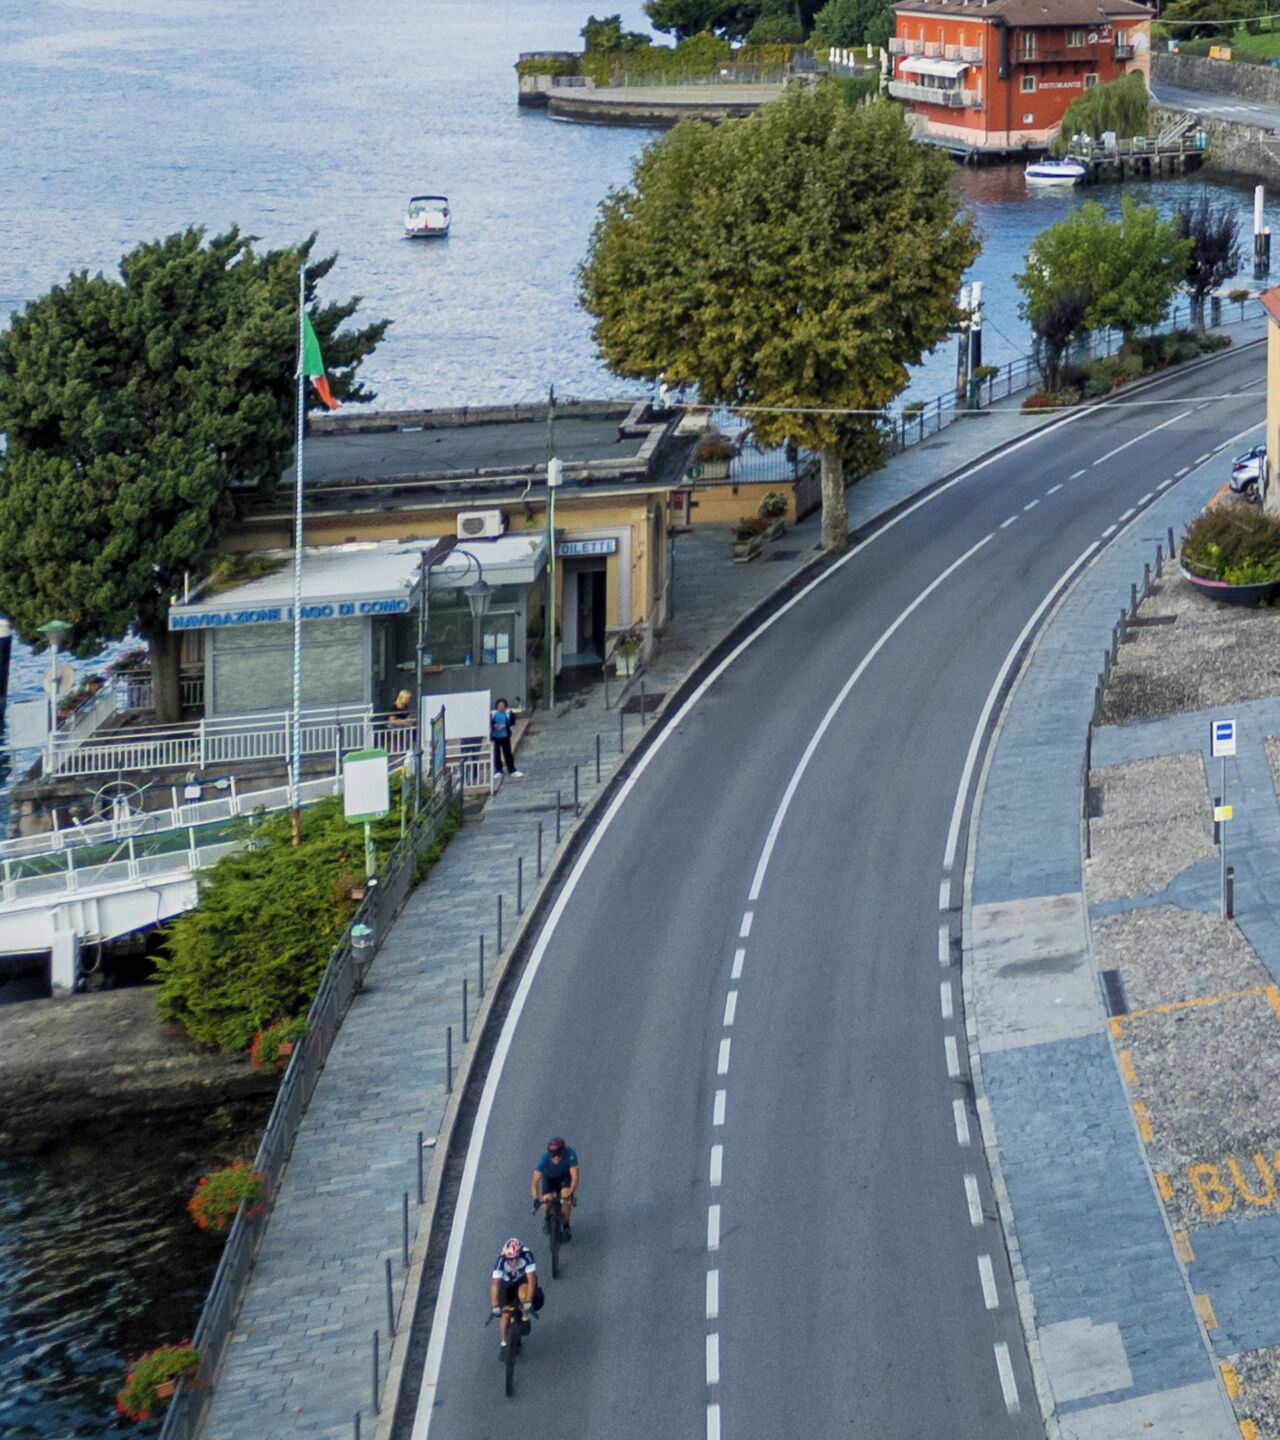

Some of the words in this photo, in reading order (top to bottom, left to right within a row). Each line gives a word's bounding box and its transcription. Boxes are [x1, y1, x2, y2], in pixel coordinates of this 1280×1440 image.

[172, 609, 282, 629] NAVIGAZIONE
[288, 604, 334, 621] LAGO
[338, 603, 355, 615] DI
[360, 598, 409, 613] COMO
